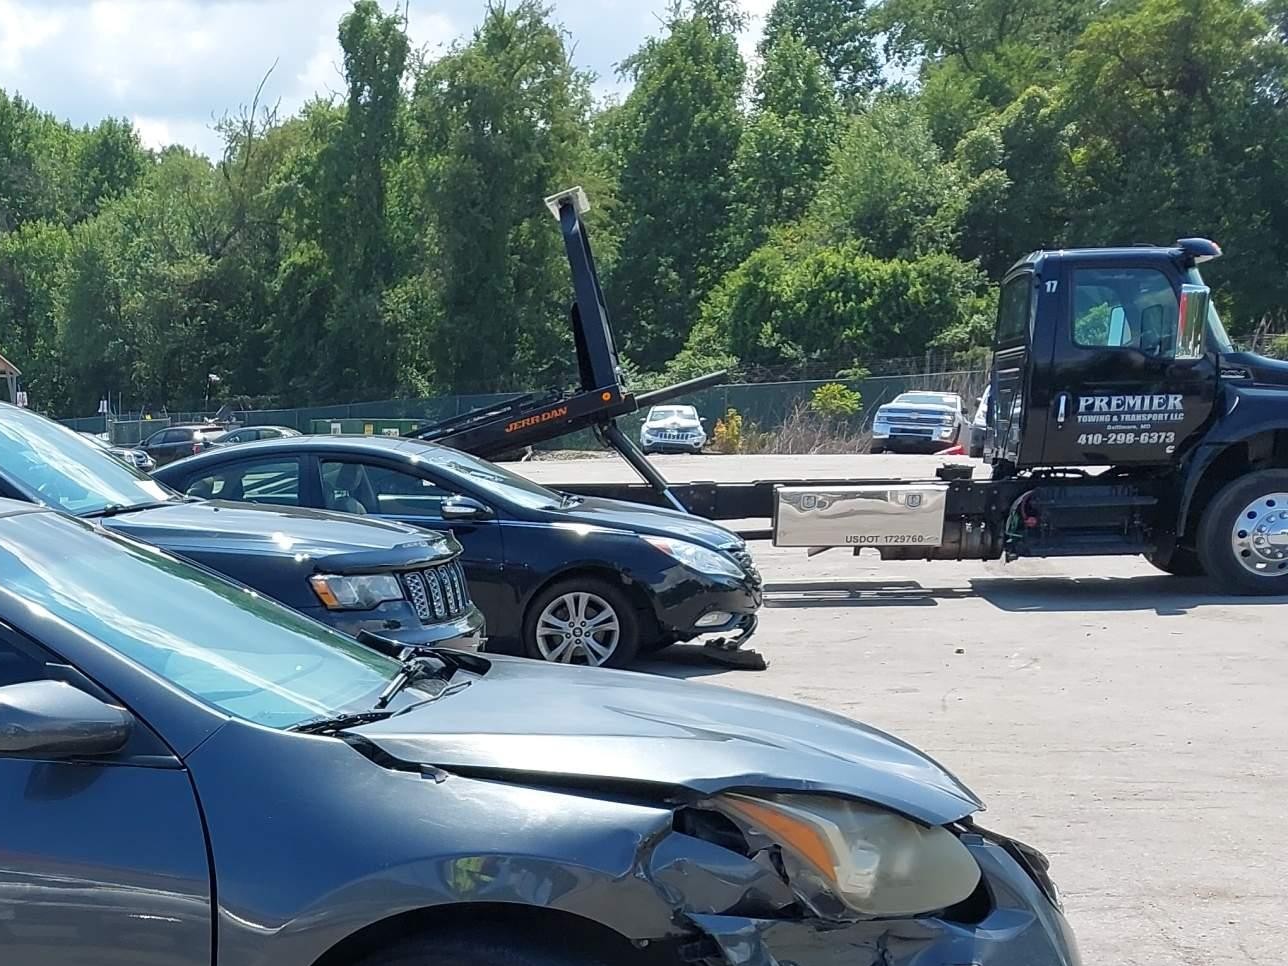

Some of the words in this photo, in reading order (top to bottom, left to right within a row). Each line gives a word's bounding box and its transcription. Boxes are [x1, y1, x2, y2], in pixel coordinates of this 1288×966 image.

[1045, 280, 1058, 293] 17
[1078, 394, 1184, 413] PREMIER
[1077, 414, 1110, 423] TOWING
[1120, 413, 1169, 423] TRANSPORT
[1170, 412, 1185, 421] LLC
[1077, 432, 1175, 445] 410-298-6373
[845, 535, 880, 543] USDOT
[884, 535, 924, 543] 1729760
